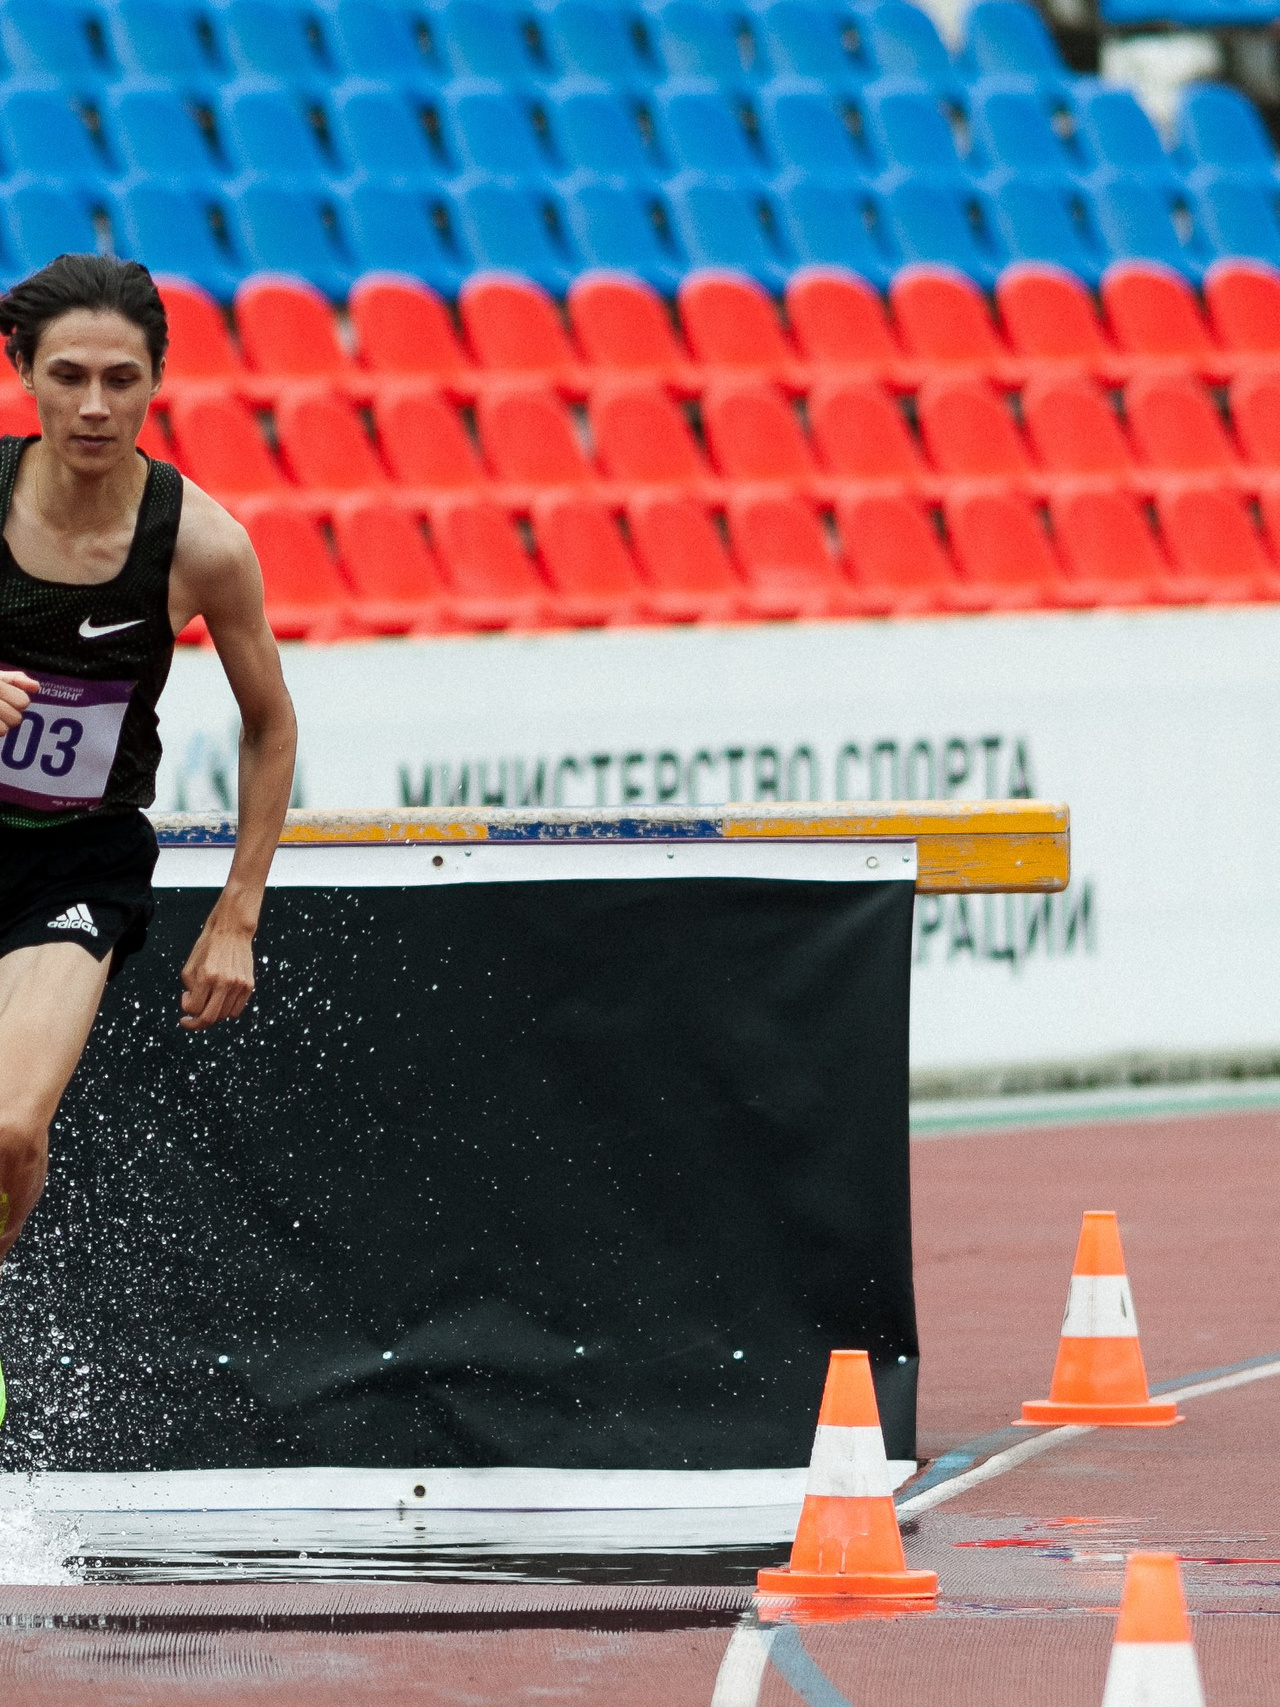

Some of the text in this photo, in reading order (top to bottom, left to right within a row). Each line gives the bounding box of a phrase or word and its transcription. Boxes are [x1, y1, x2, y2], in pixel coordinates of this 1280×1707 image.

[40, 682, 84, 693] АЛТИЙСКИЙ
[398, 736, 1035, 806] МИНИСТЕРСТВО СПОРТА
[46, 919, 99, 937] adidas
[914, 879, 1096, 974] РАЦИИ
